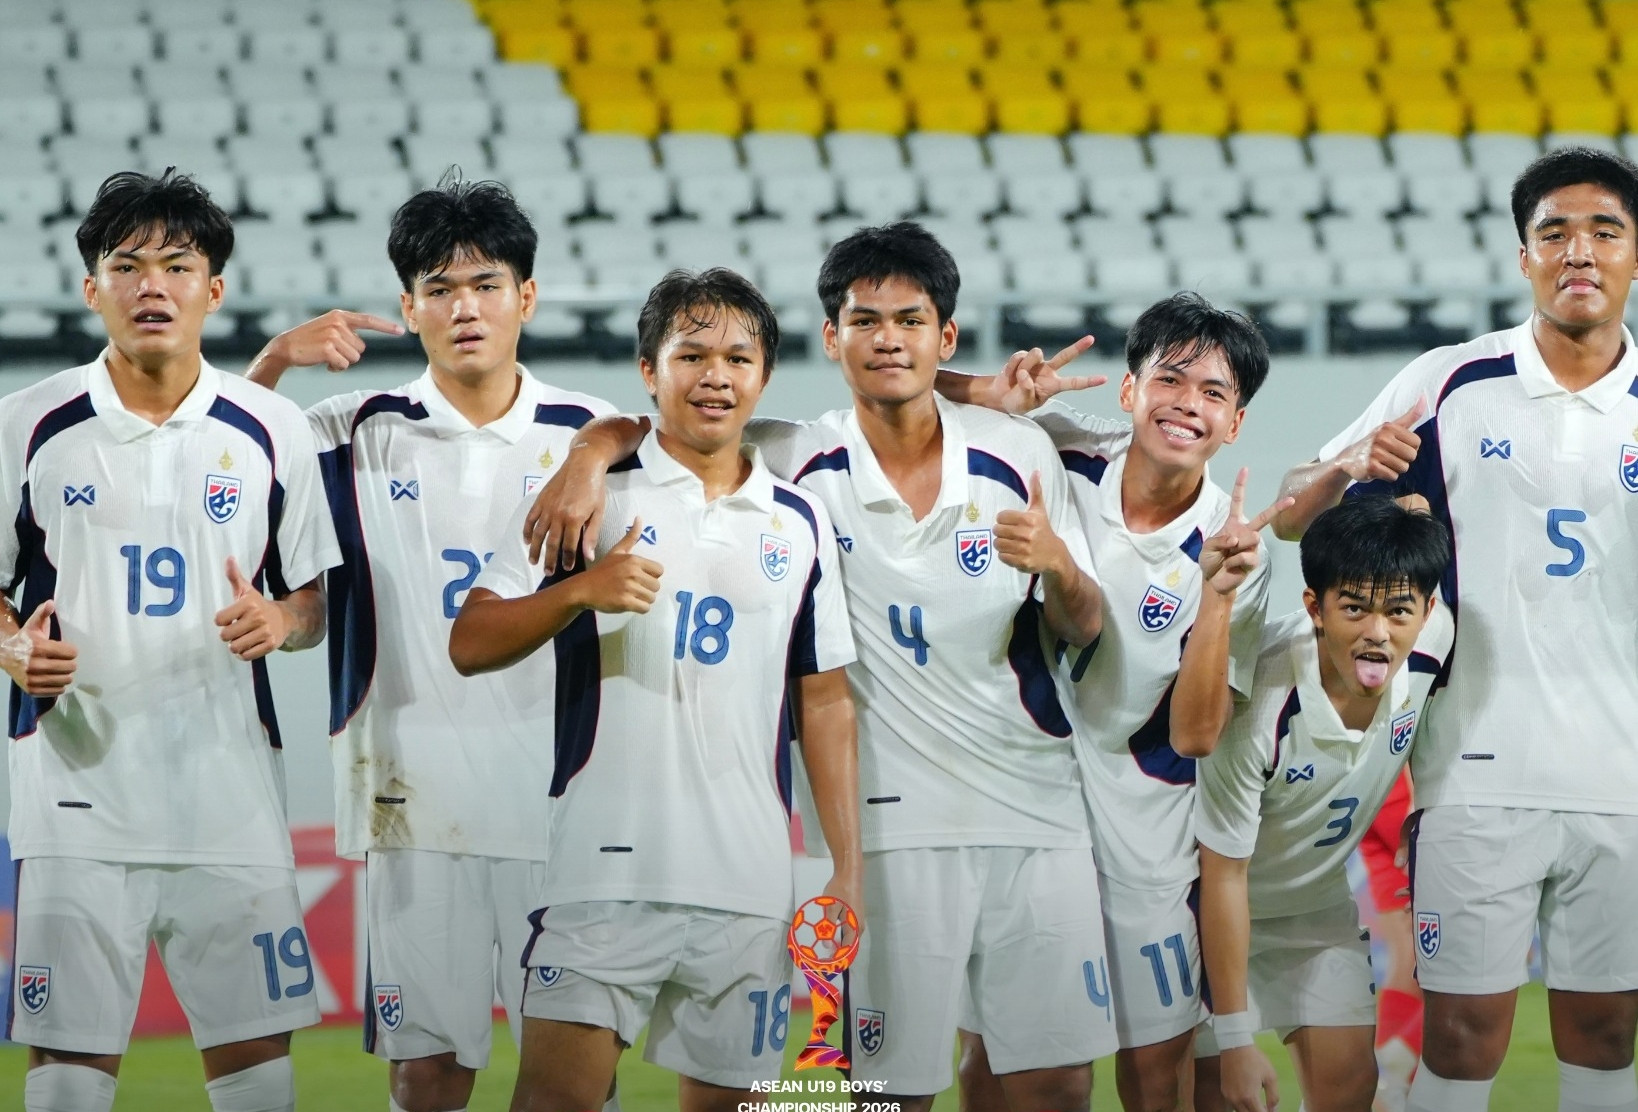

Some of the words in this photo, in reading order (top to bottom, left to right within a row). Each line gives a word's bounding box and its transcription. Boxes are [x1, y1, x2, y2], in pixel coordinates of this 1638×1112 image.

[210, 478, 239, 488] THAILAND
[1545, 508, 1587, 577] 5
[119, 545, 186, 617] 19
[441, 548, 494, 619] 2
[1150, 589, 1178, 607] THAILAND
[674, 590, 734, 665] 18
[888, 604, 930, 667] 4
[1314, 797, 1359, 848] 3
[252, 926, 314, 1002] 19
[1140, 932, 1194, 1008] 11
[748, 983, 791, 1058] 18
